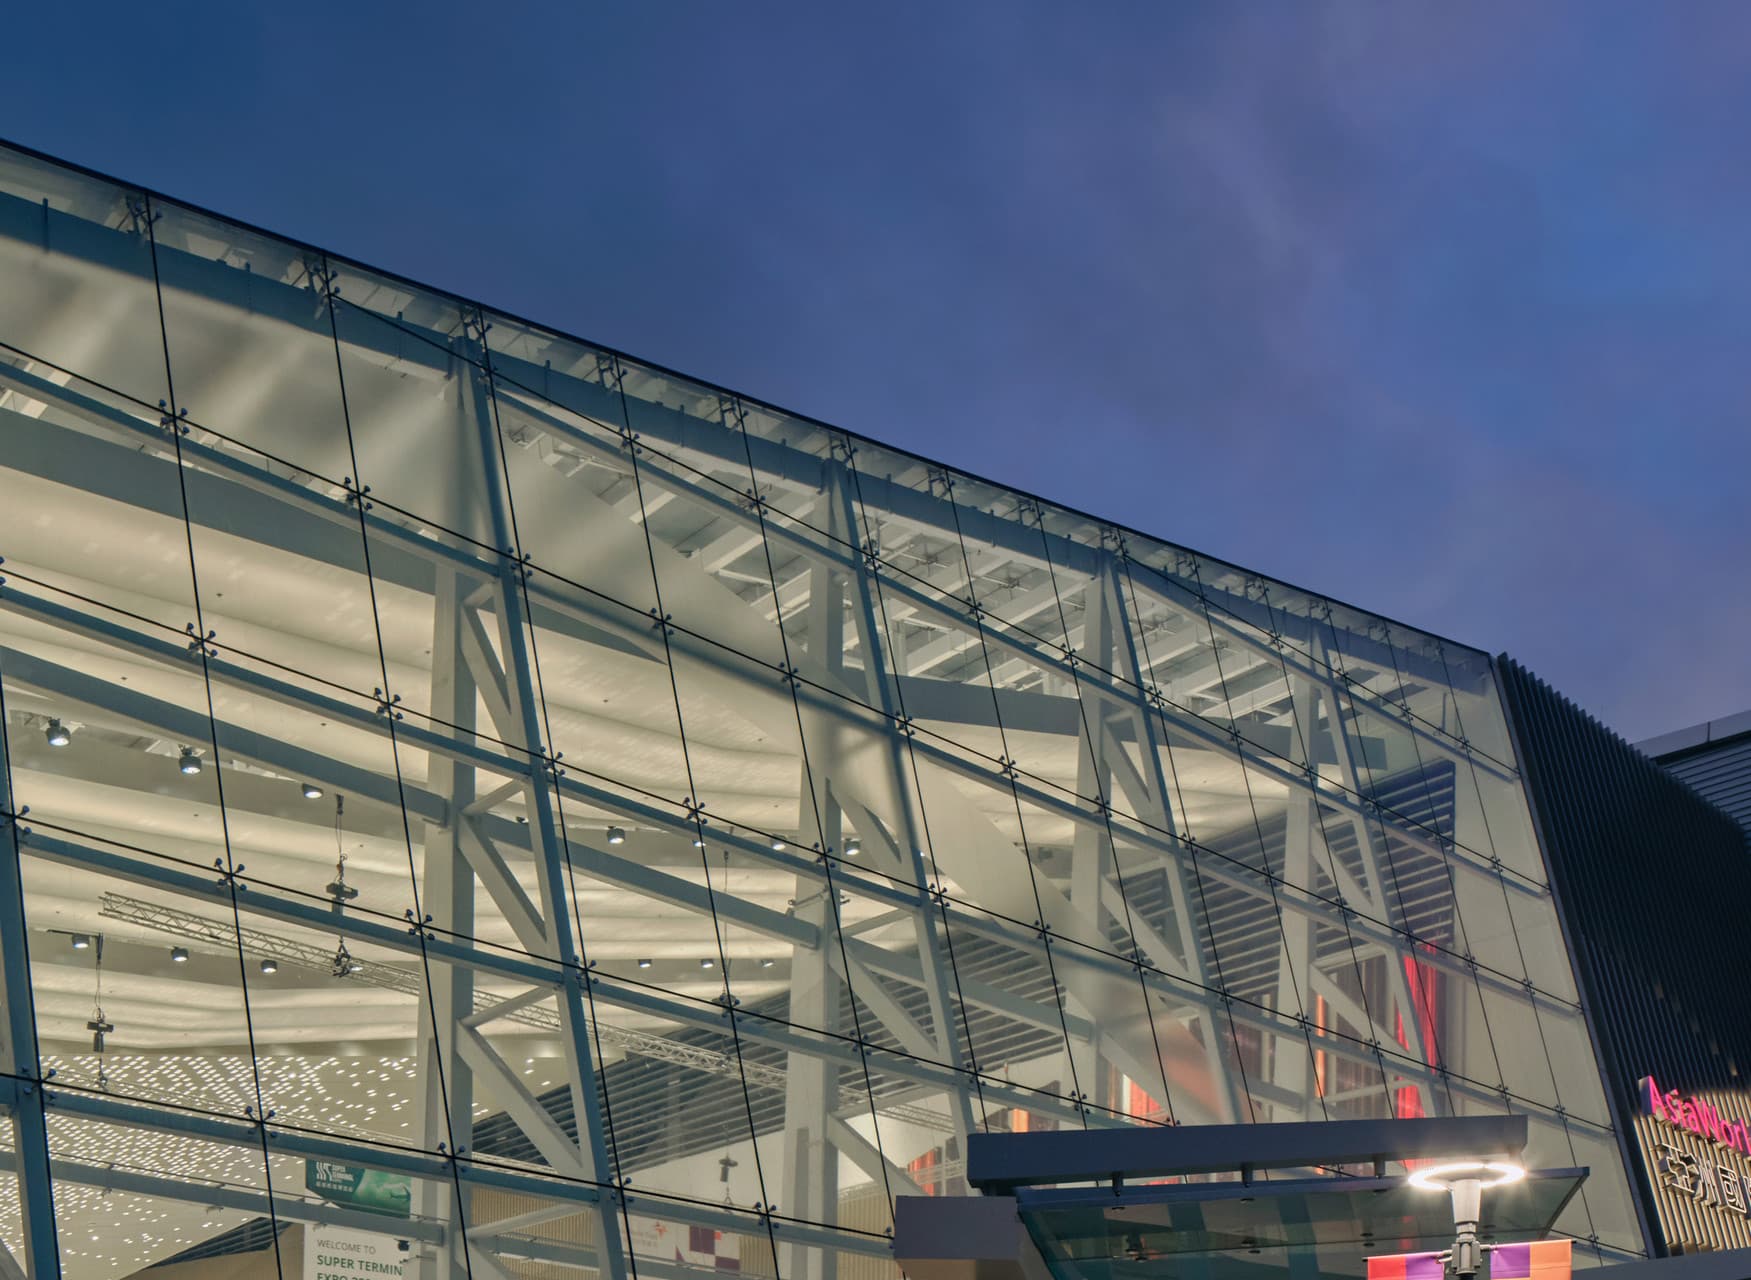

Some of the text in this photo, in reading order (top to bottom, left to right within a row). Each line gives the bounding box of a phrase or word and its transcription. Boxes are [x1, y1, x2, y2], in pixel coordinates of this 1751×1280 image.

[1648, 1075, 1751, 1154] AsiaWorl
[1661, 1143, 1751, 1213] 亞洲國
[317, 1240, 376, 1255] WELCOME TO
[317, 1255, 354, 1269] SUPER
